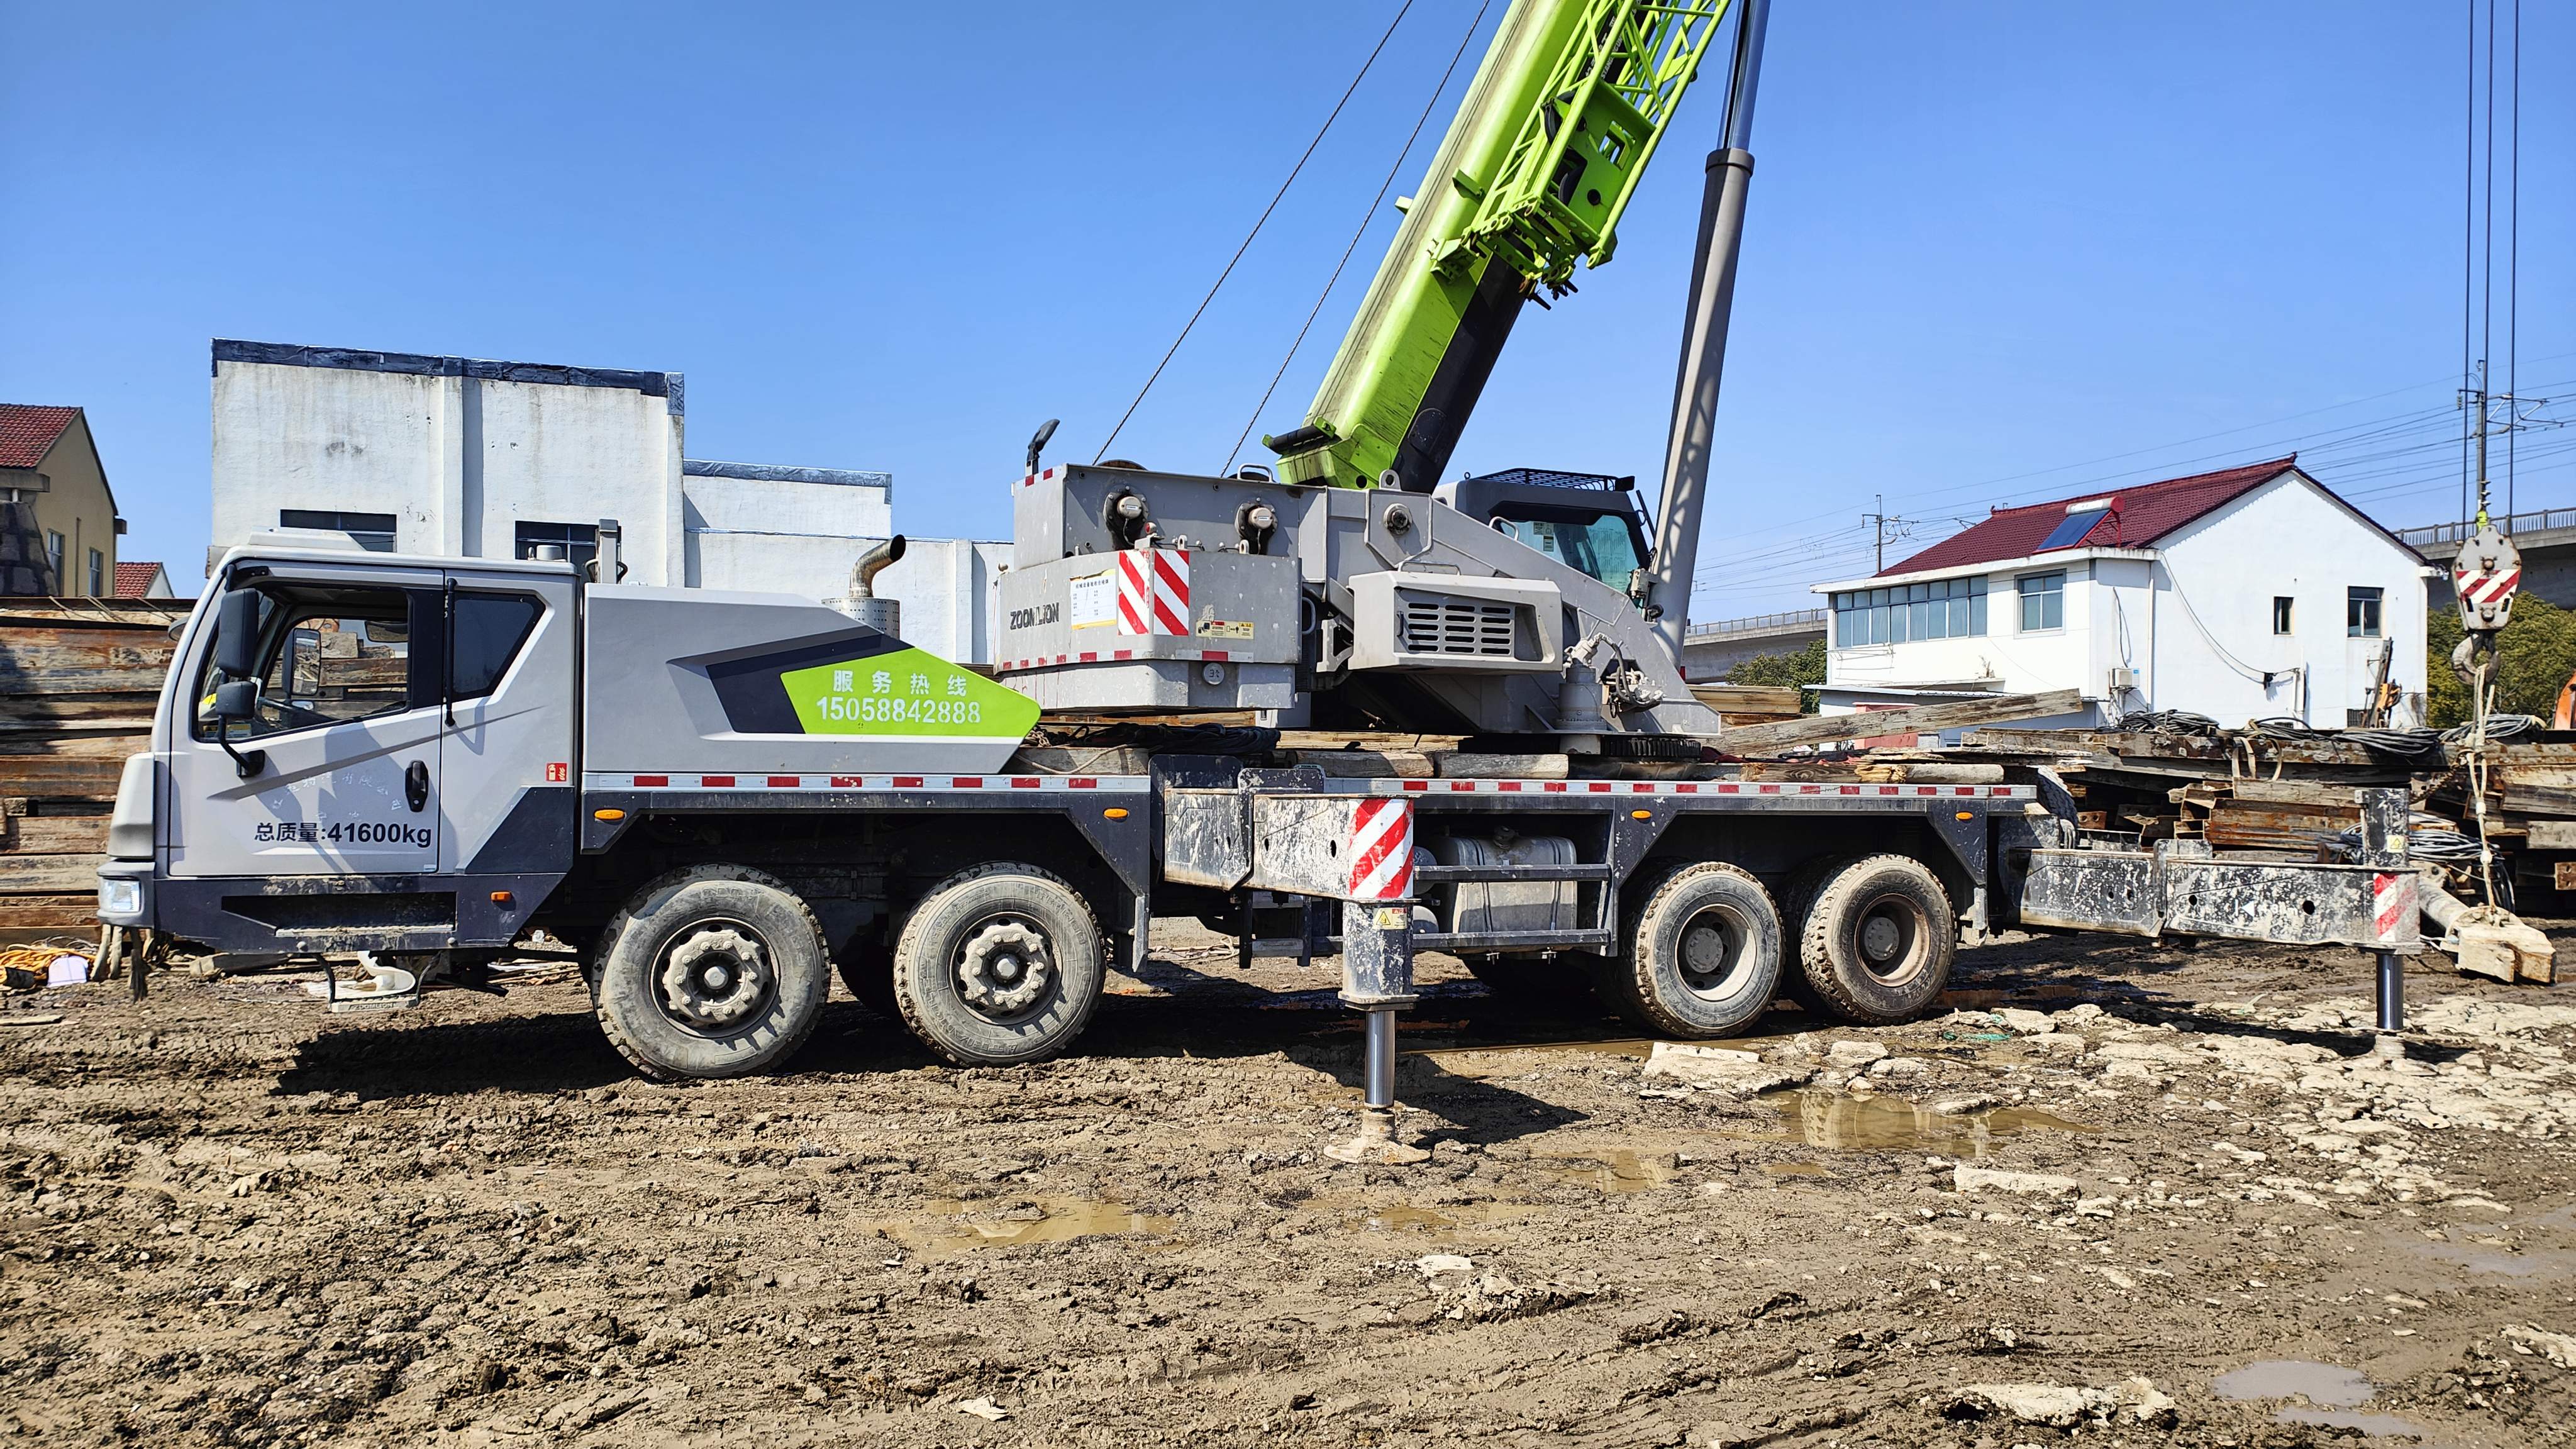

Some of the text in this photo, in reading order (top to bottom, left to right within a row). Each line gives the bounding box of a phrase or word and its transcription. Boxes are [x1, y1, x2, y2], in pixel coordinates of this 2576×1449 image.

[833, 670, 967, 697] 服务热线
[816, 696, 981, 724] 15058842888
[254, 822, 431, 848] 总质量:41600kg
